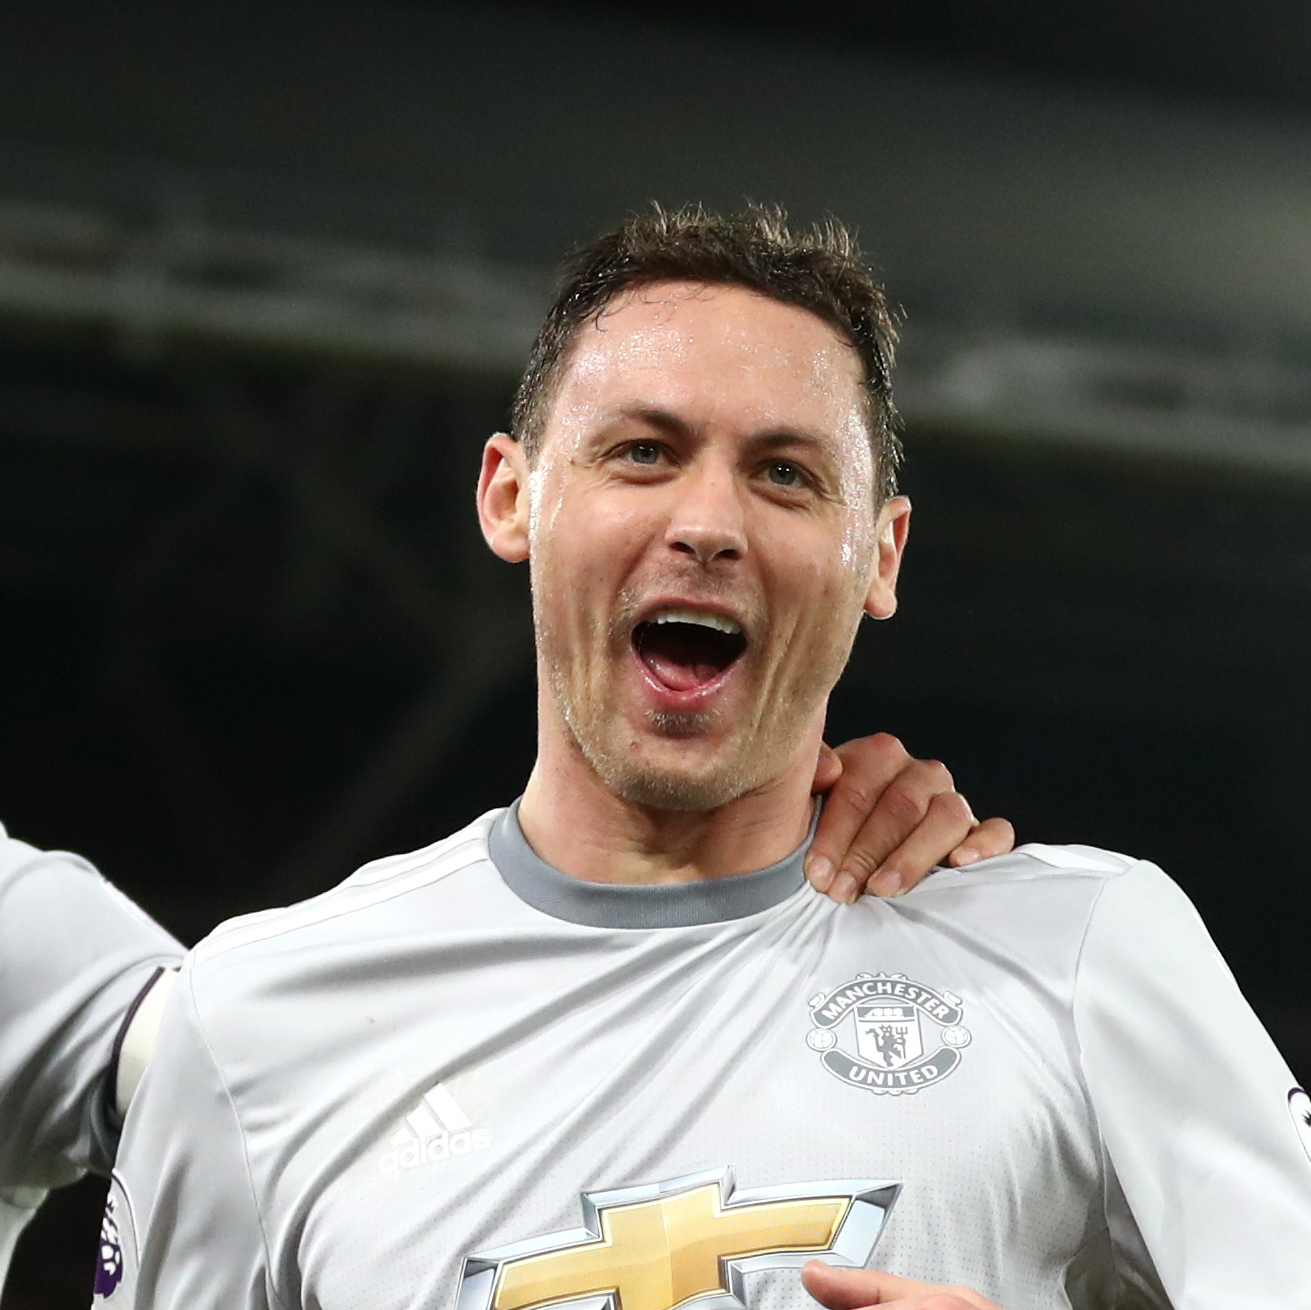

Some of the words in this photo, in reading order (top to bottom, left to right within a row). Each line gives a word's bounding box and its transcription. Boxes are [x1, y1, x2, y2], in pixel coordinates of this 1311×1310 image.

[821, 981, 950, 1020] MANCHESTER
[848, 1064, 939, 1087] UNITED
[377, 1127, 492, 1175] adidas
